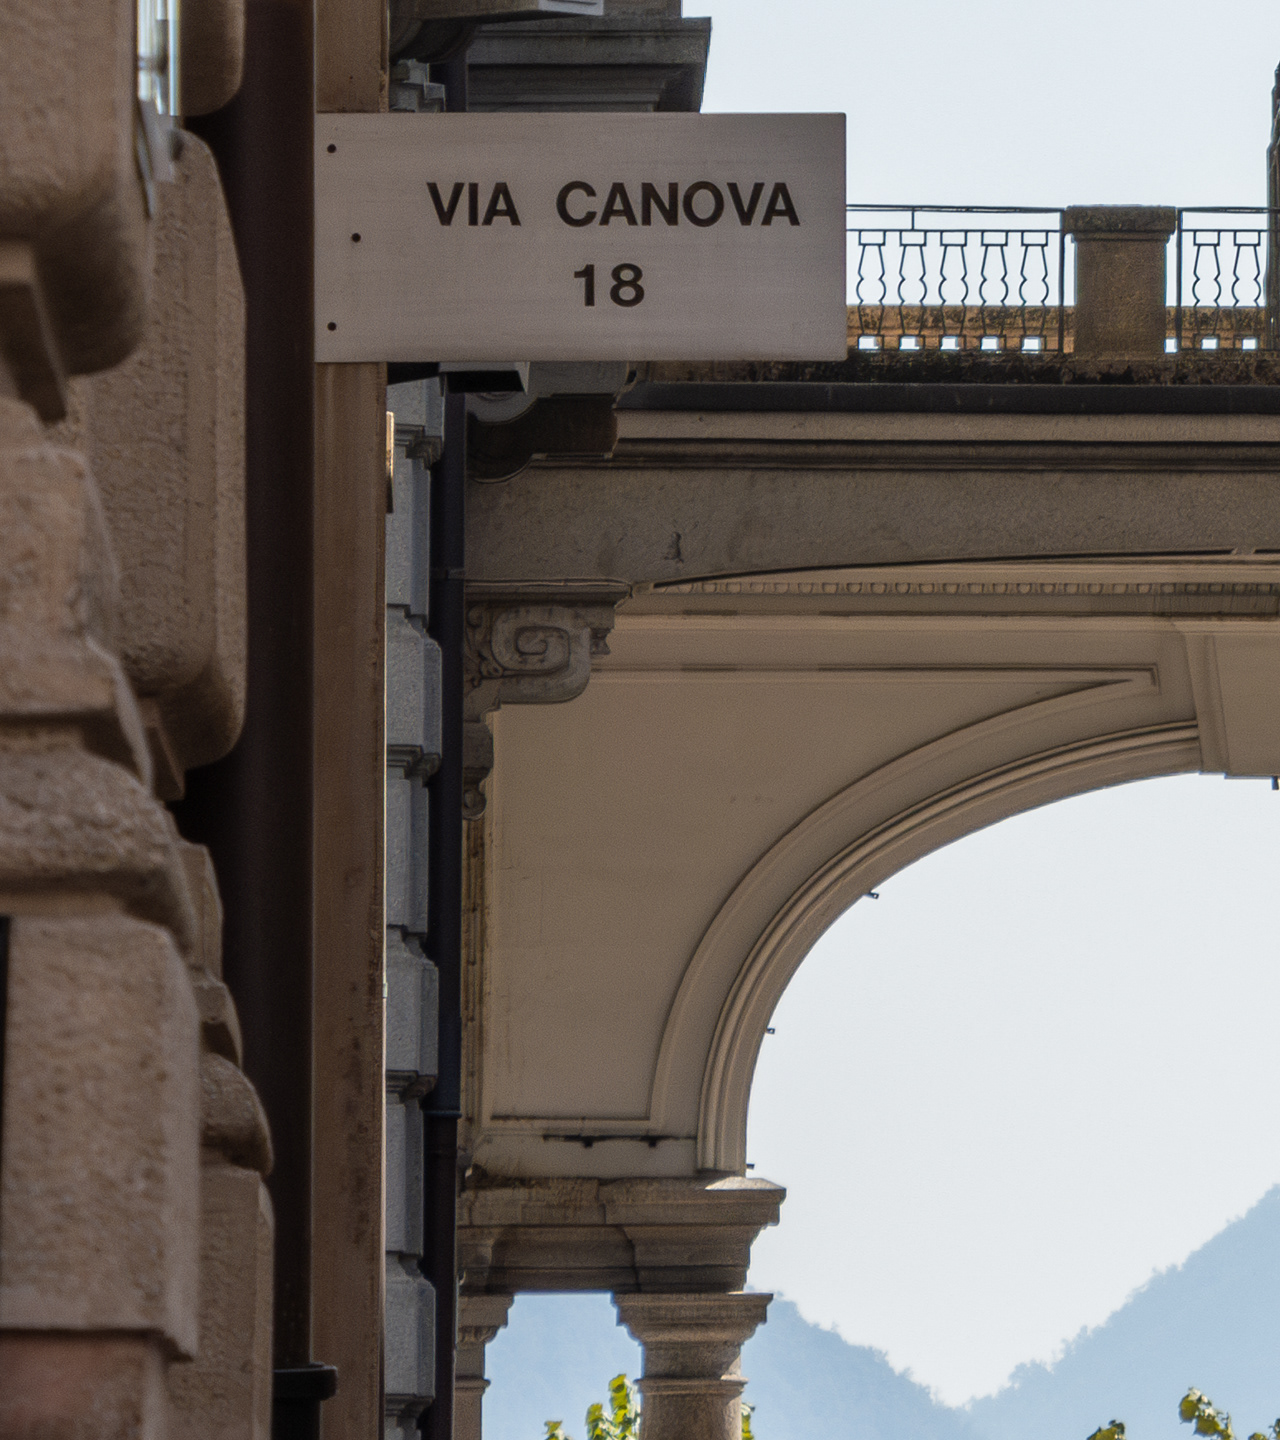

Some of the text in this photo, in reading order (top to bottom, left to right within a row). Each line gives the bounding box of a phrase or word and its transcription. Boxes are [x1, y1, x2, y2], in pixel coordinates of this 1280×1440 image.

[426, 180, 801, 228] VIA CANOVA
[573, 262, 646, 308] 18
